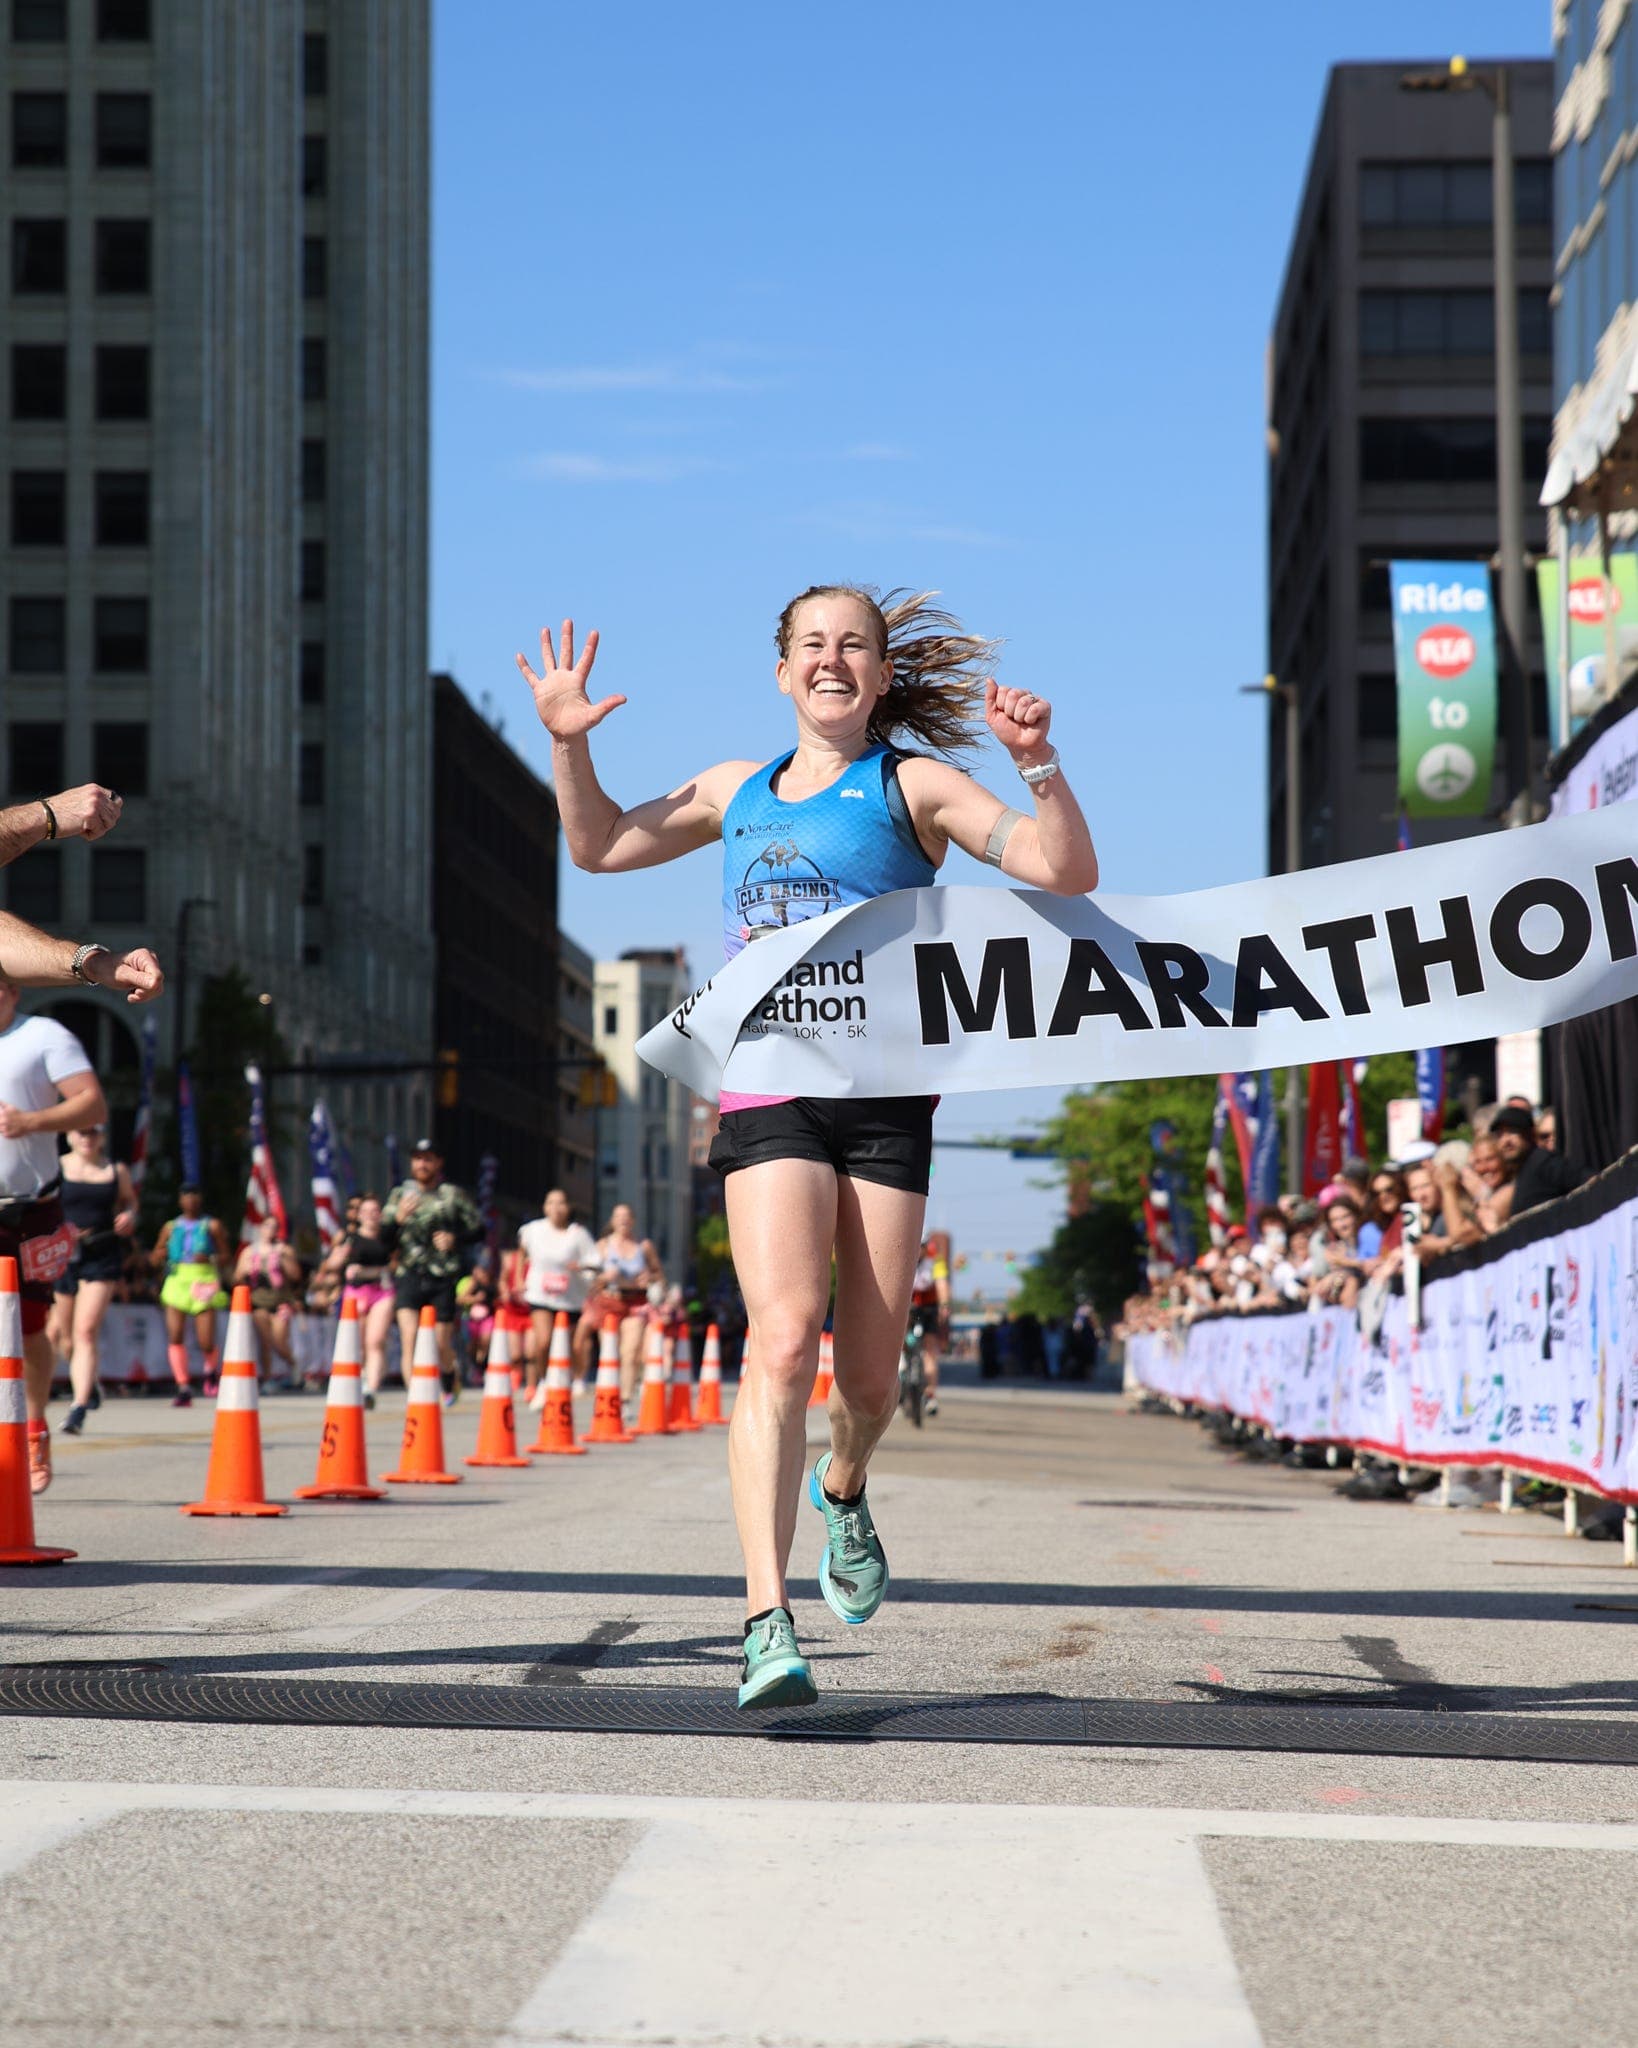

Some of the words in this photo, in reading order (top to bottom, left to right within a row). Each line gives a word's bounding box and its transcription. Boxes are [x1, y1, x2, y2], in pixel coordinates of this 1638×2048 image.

[1400, 583, 1488, 613] Ride
[1428, 696, 1469, 729] to
[740, 886, 765, 908] CLE
[770, 882, 830, 899] RACING
[793, 1026, 823, 1040] 10K
[848, 1025, 868, 1039] 5K
